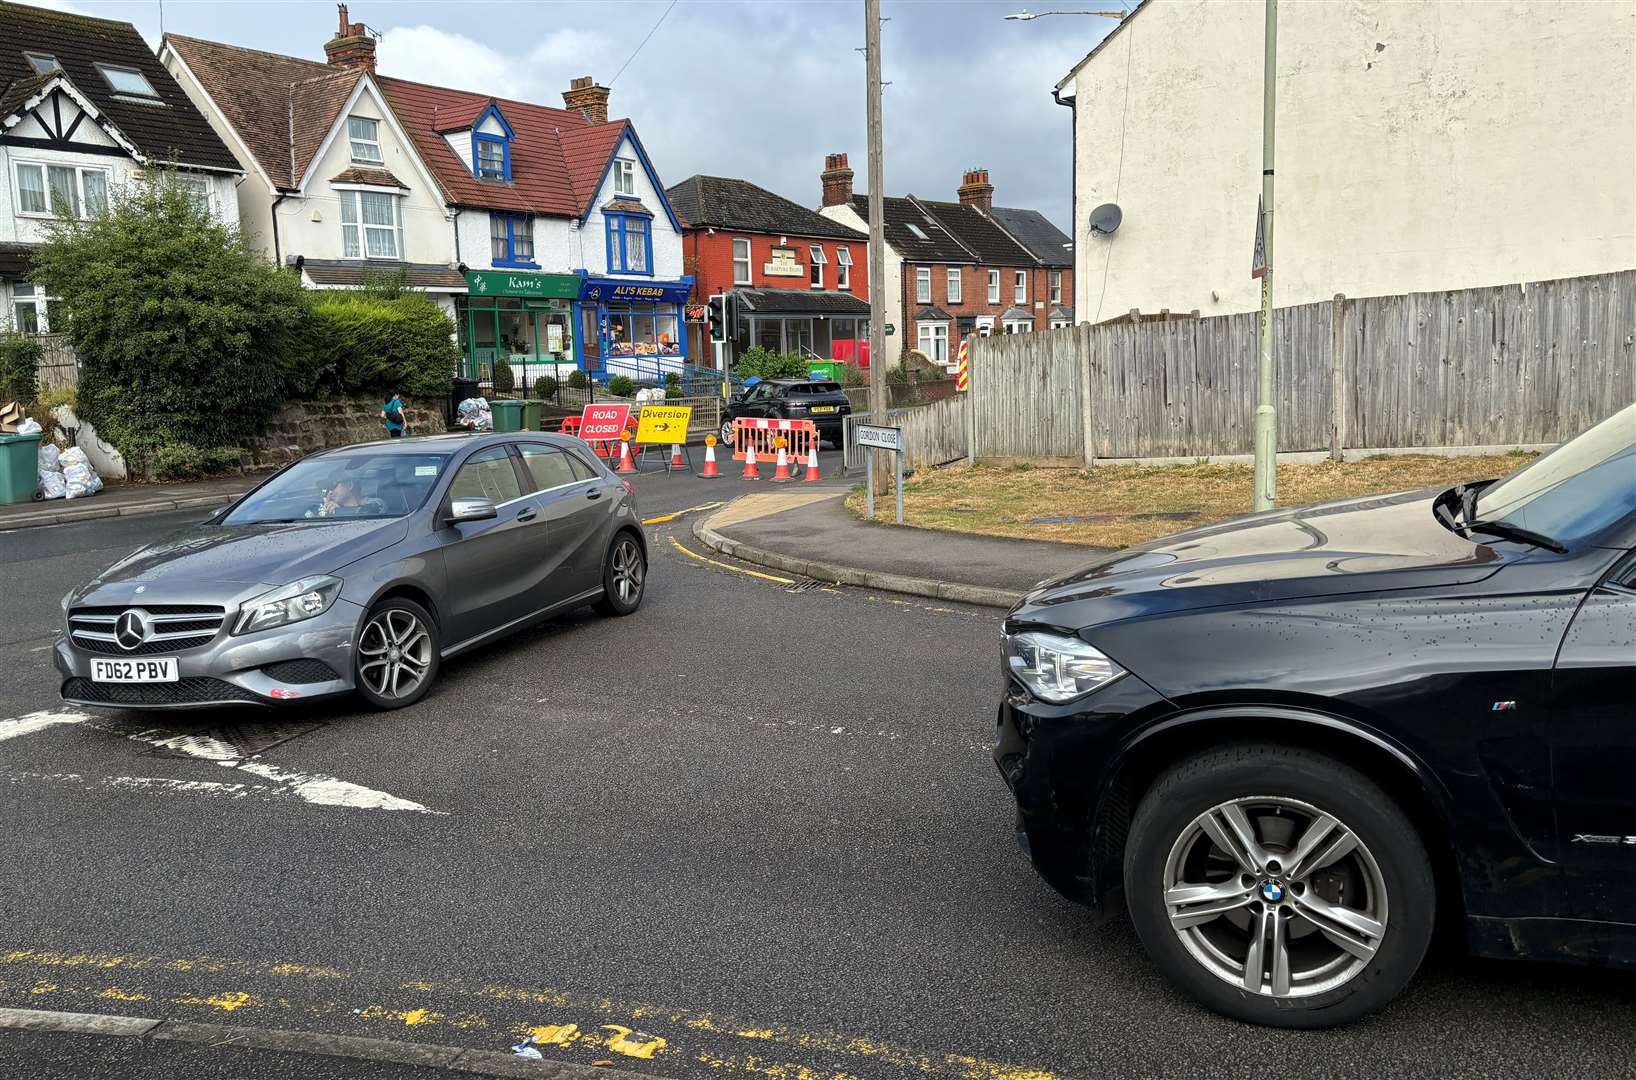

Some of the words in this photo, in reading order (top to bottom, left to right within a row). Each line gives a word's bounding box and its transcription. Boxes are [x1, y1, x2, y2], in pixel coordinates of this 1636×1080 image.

[508, 276, 542, 289] Kam's
[614, 286, 635, 295] ALI'S
[636, 287, 664, 297] KEBAB
[592, 410, 618, 420] ROAD
[642, 409, 688, 419] Diversion
[585, 424, 619, 434] CLOSED
[860, 430, 880, 442] GORDON
[881, 432, 896, 445] CLOSE
[96, 661, 133, 680] FD62
[136, 661, 168, 680] PBV
